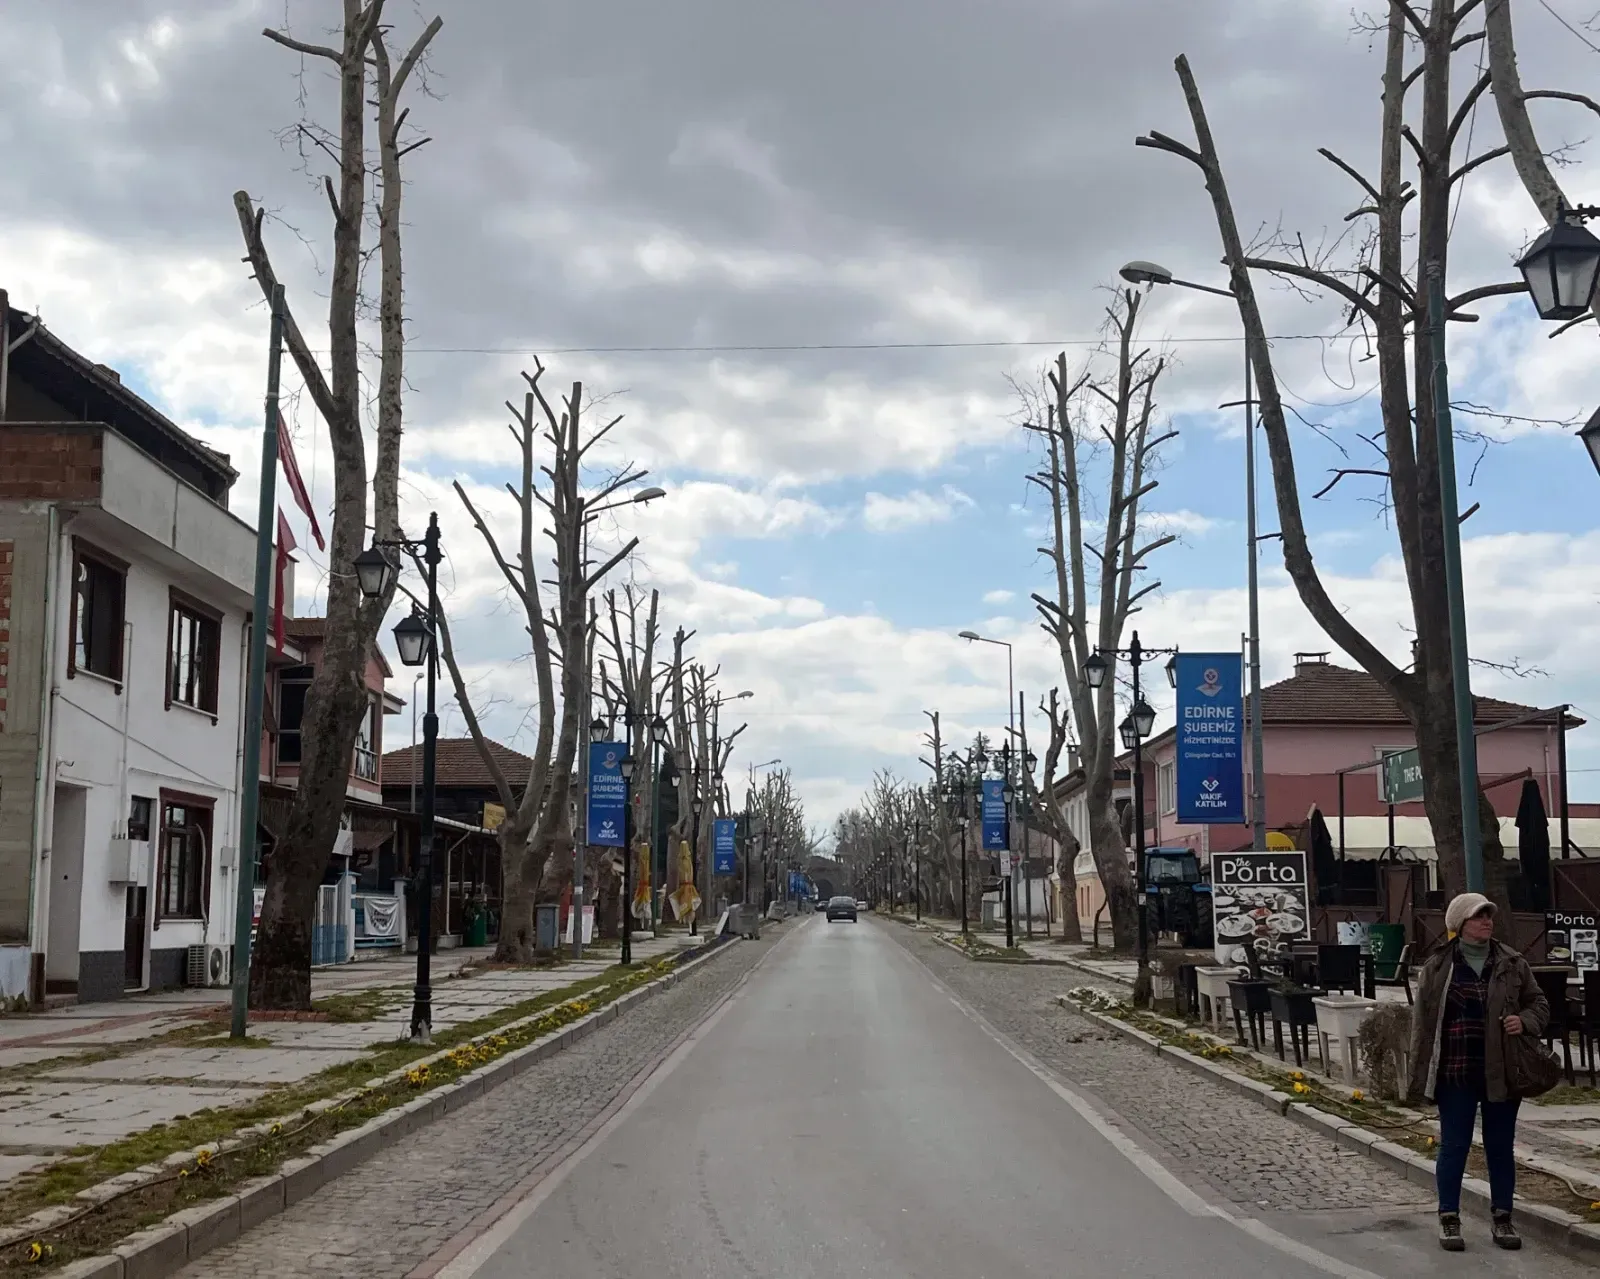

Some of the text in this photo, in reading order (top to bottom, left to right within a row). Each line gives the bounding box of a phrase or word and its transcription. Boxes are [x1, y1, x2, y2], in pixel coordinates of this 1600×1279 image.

[1184, 704, 1235, 718] EDİRNE
[1184, 720, 1236, 735] ŞUBEMİZ
[1183, 736, 1236, 744] HİZMETİNİZDE
[593, 774, 624, 783] EDİRNE
[1403, 767, 1414, 783] THE
[1195, 800, 1227, 808] KATILIM
[1221, 857, 1296, 882] the Porta
[1555, 913, 1594, 925] Porta
